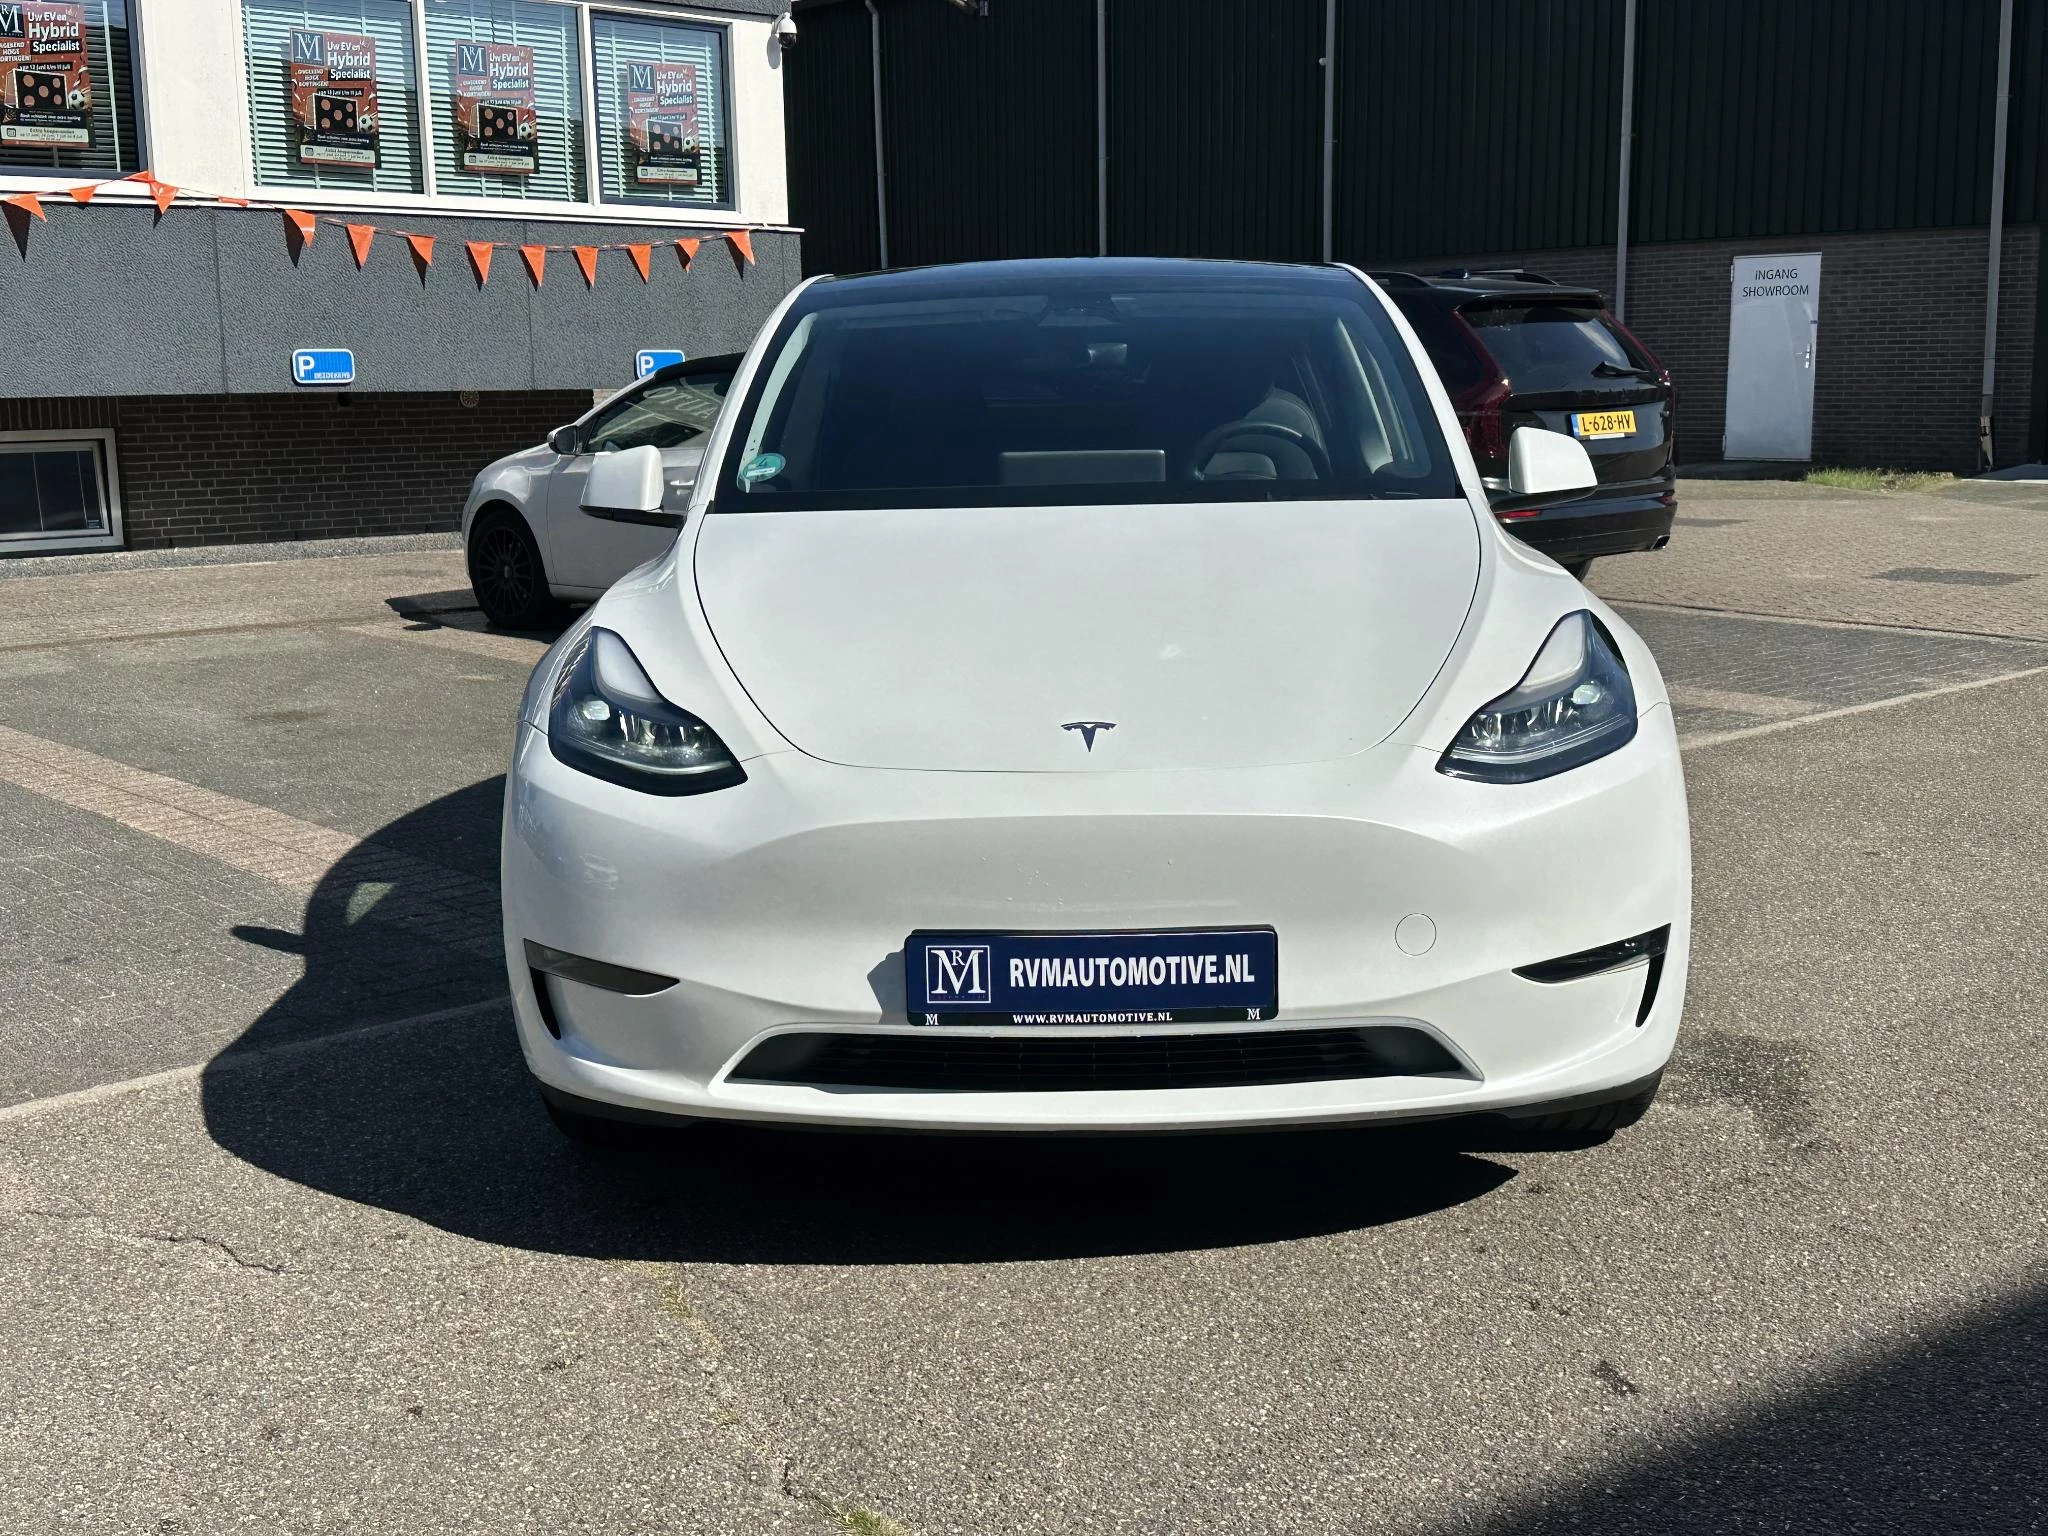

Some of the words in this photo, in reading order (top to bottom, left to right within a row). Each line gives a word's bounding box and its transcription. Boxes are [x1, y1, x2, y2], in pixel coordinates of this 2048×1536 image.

[28, 12, 43, 21] Uw
[44, 12, 56, 21] EV
[28, 22, 79, 41] Hybrid
[33, 40, 80, 53] Specialist
[327, 41, 340, 51] Uw
[341, 42, 352, 51] EV
[327, 51, 370, 69] Hybrid
[489, 53, 501, 62] Uw
[503, 54, 511, 62] EV
[330, 69, 372, 80] Specialist
[489, 63, 529, 79] Hybrid
[492, 79, 529, 90] Specialist
[656, 80, 692, 96] Hybrid
[660, 95, 692, 106] Specialist
[1755, 268, 1798, 281] INGANG
[1742, 285, 1809, 298] SHOWROOM
[298, 355, 315, 377] P
[640, 355, 654, 376] P
[1581, 414, 1631, 432] L-628-HV
[1009, 954, 1255, 988] RVMAUTOMOTIVE.NL
[1012, 1012, 1173, 1024] WWW.RVMAUTOMOTIVE.NL
